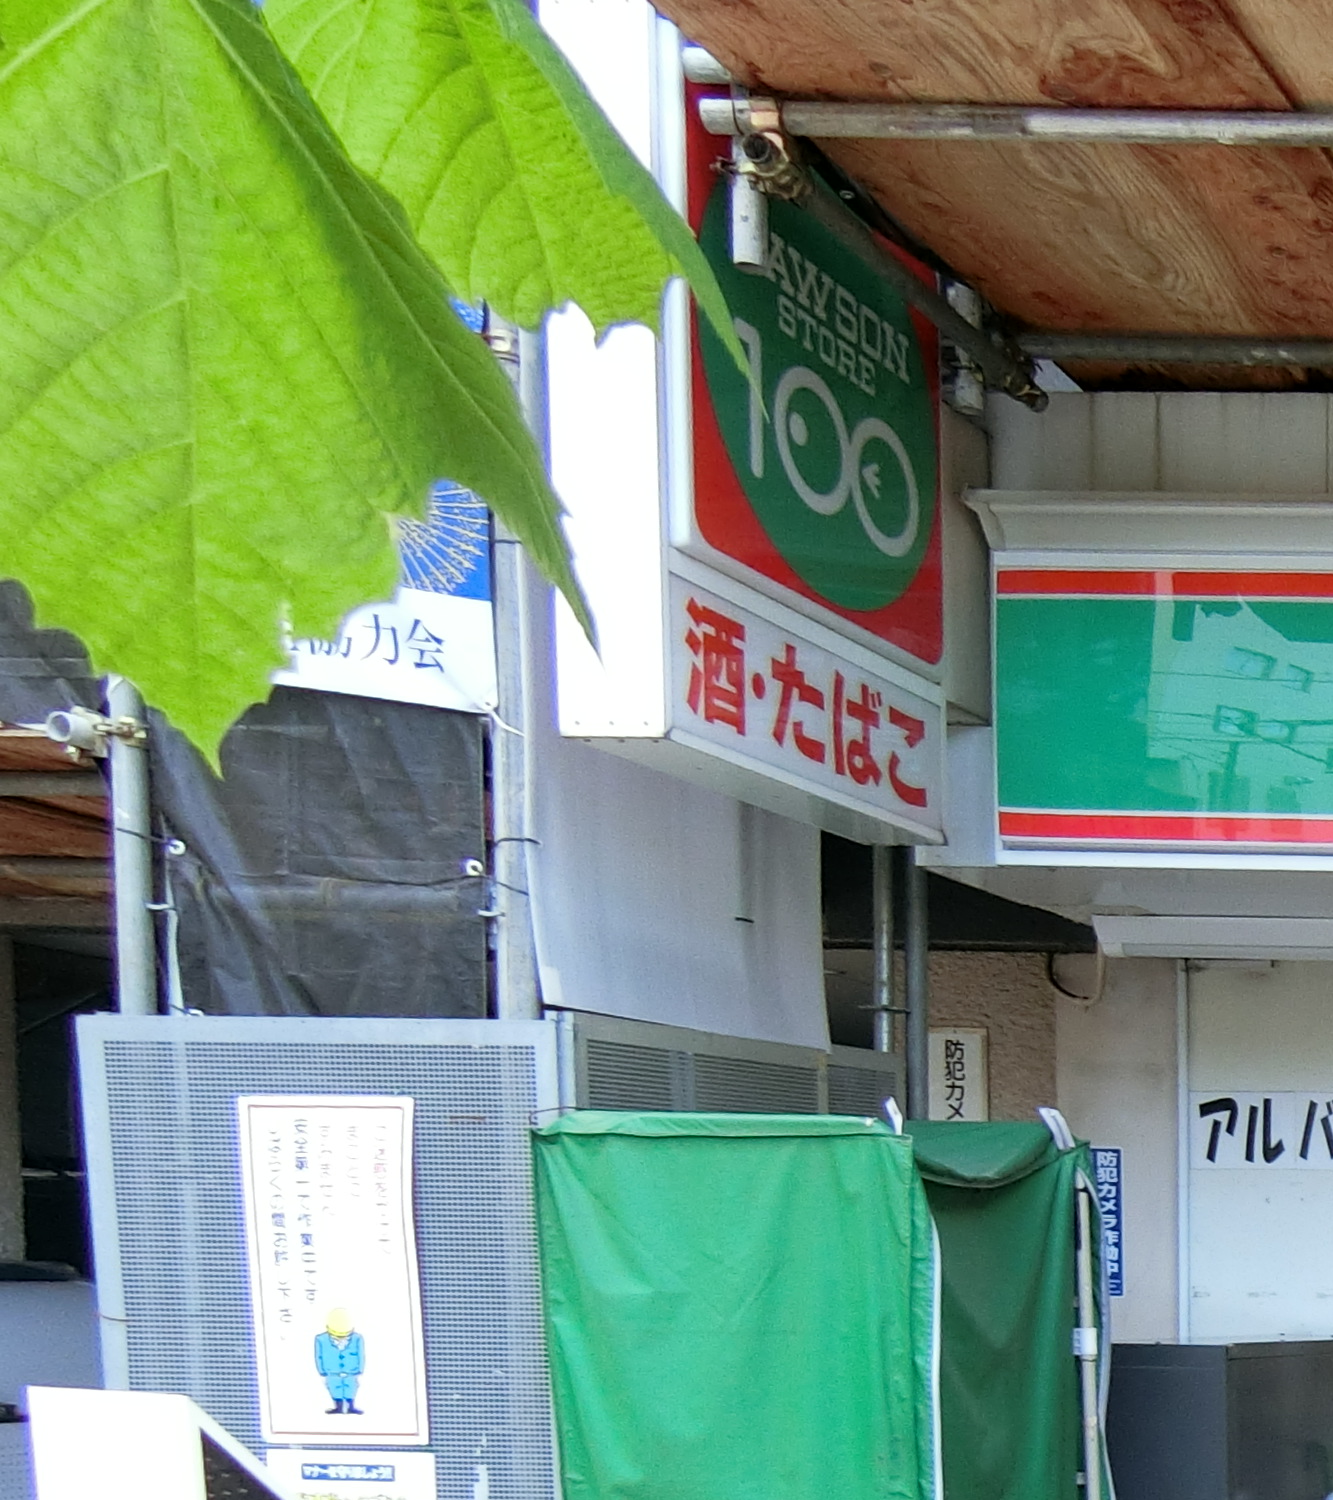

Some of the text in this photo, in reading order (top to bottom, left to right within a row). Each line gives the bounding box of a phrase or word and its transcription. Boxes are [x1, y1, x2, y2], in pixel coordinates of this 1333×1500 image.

[766, 230, 910, 386] AWSON
[777, 293, 877, 397] STORE
[733, 317, 920, 558] 100
[684, 597, 929, 808] 酒・たばこ
[944, 1039, 966, 1120] 防犯カメ
